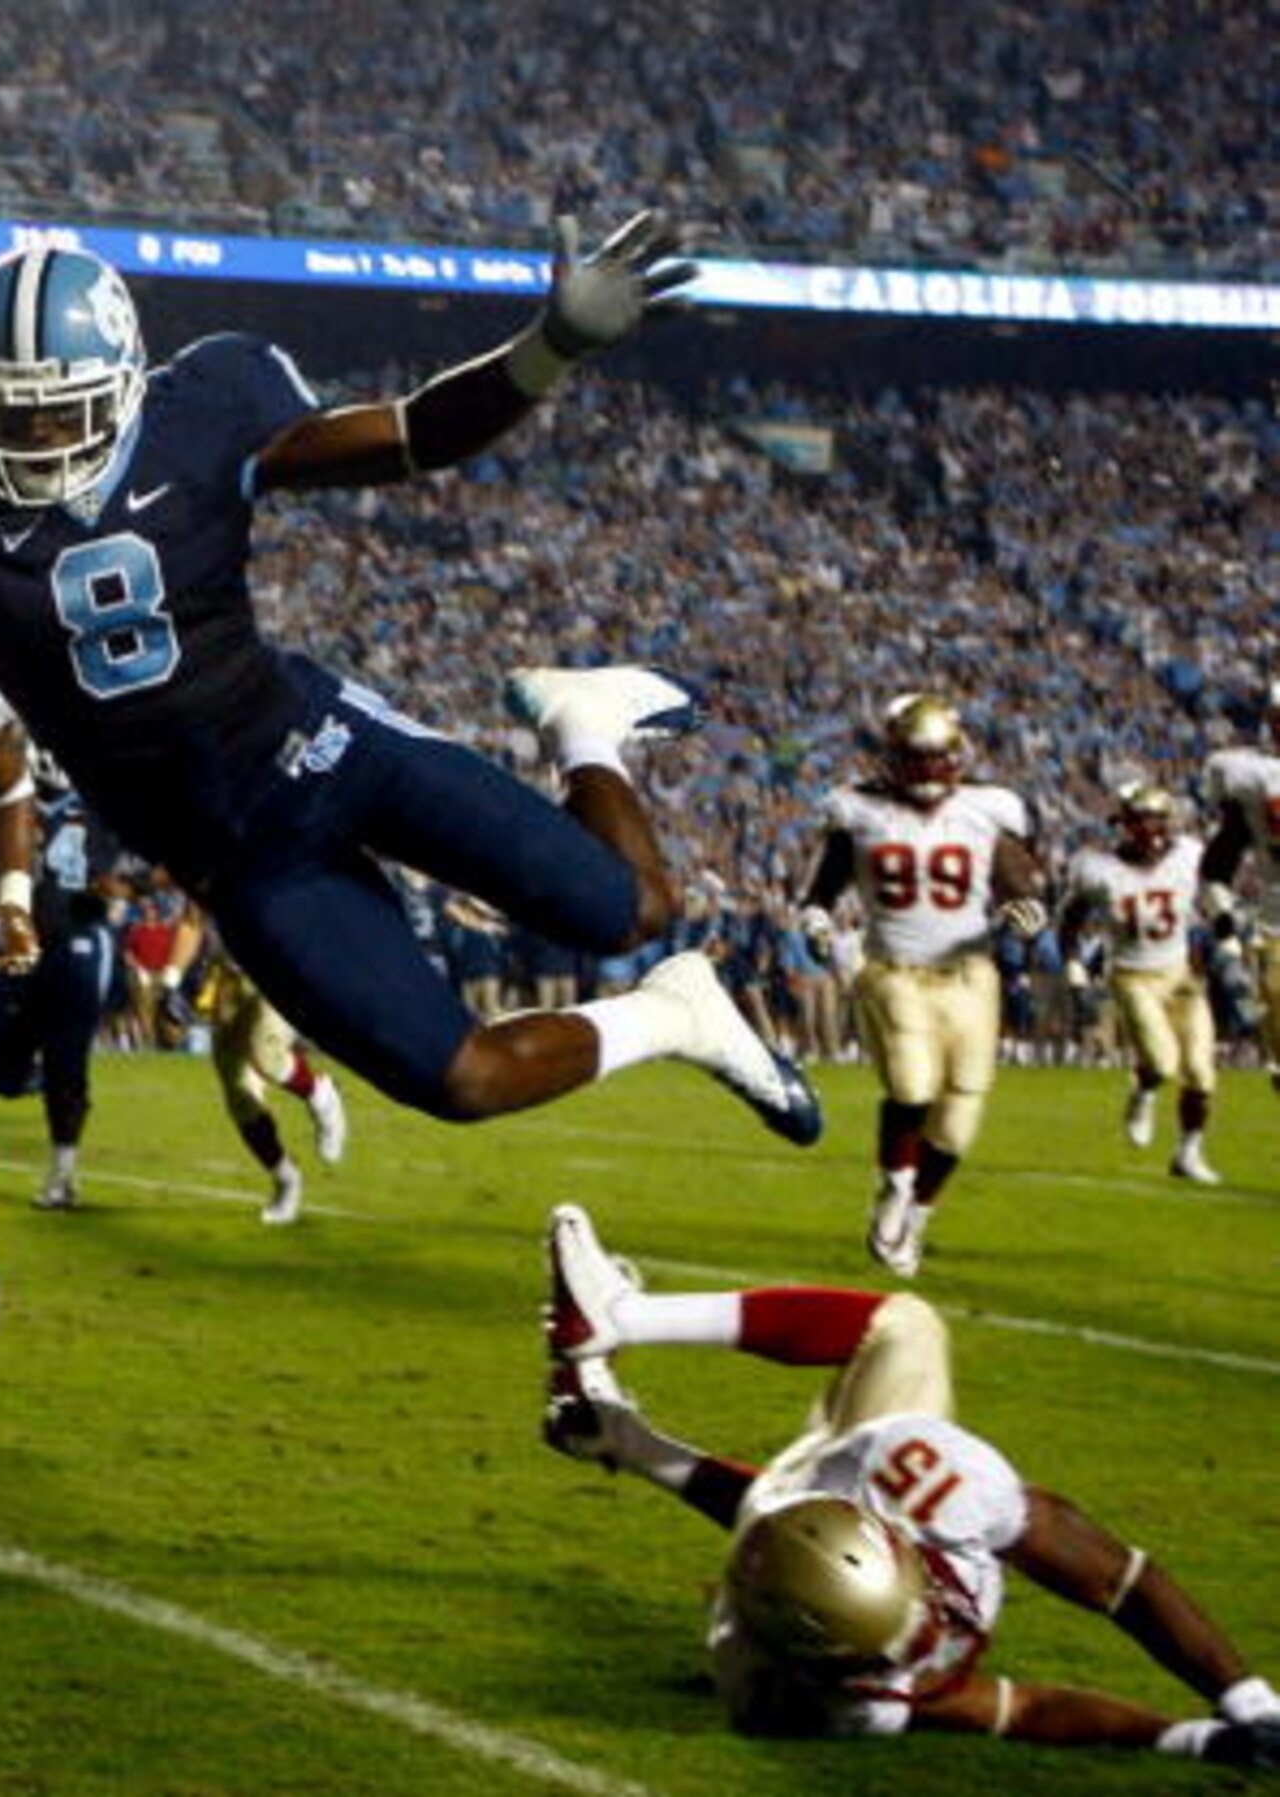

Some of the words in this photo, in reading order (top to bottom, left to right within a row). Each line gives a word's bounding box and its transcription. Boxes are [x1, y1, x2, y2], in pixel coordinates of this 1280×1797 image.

[809, 266, 1076, 320] CAROLINA
[50, 530, 182, 700] 8
[868, 841, 972, 911] 99
[868, 1437, 962, 1526] 15
